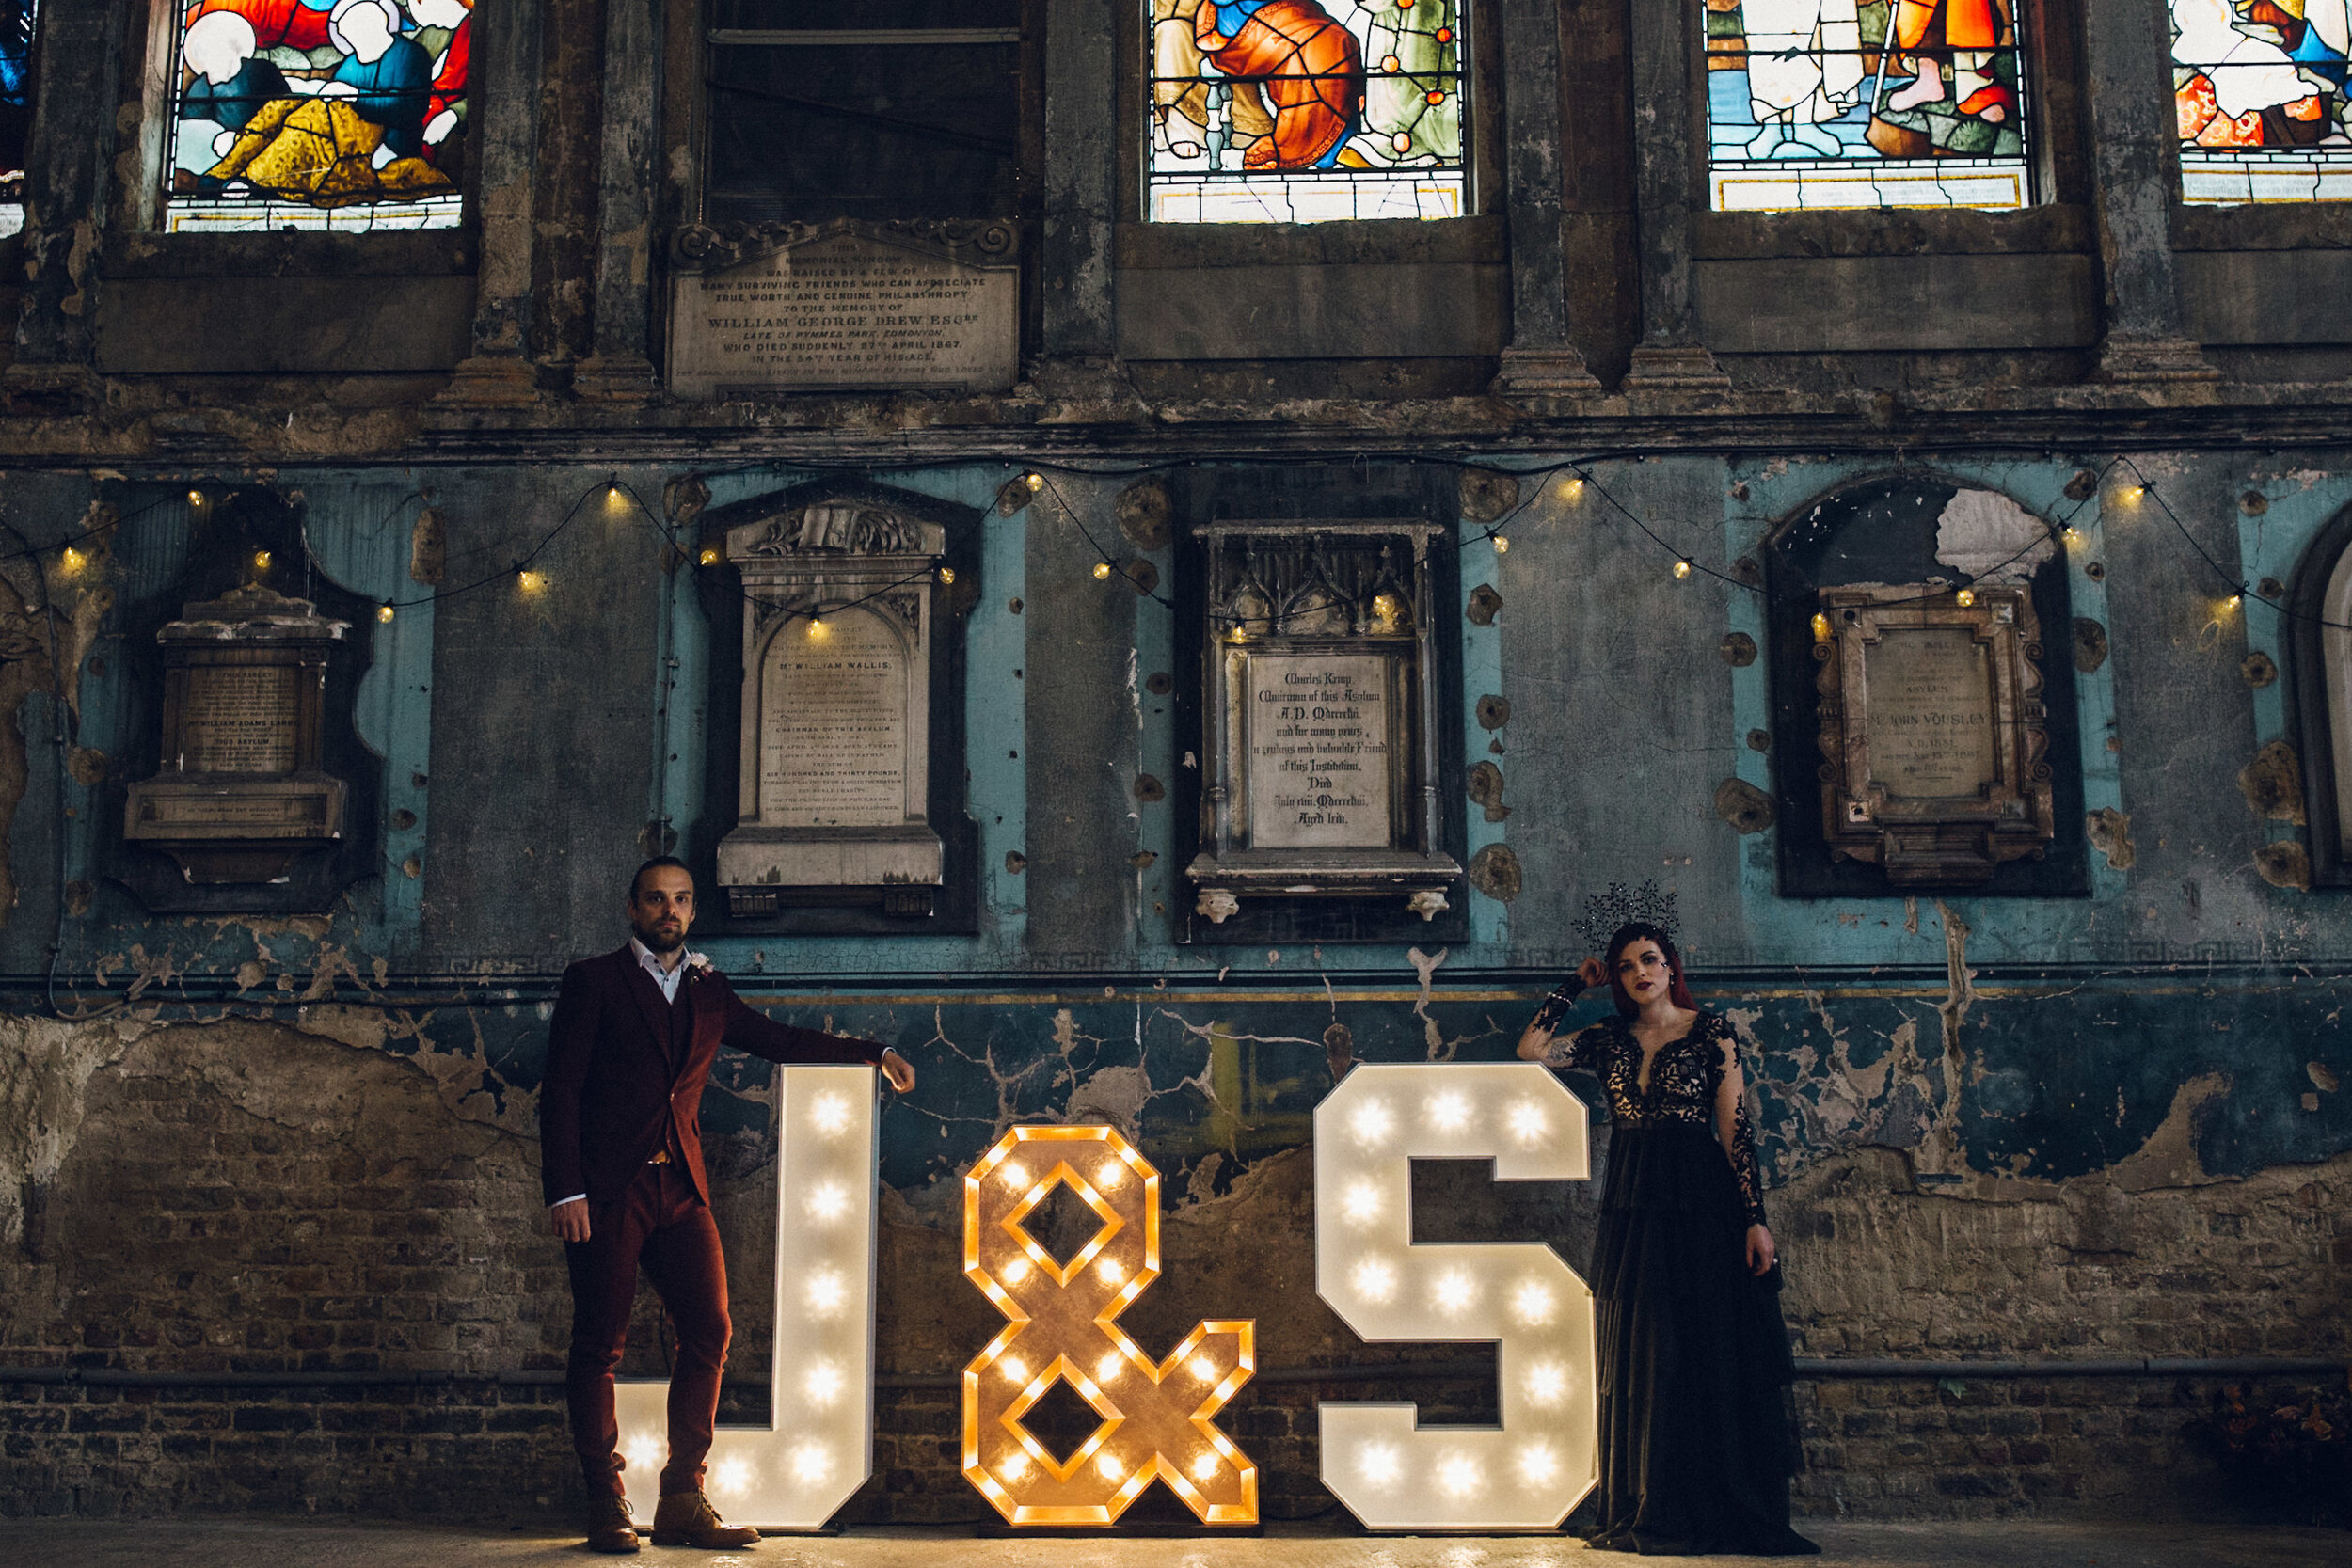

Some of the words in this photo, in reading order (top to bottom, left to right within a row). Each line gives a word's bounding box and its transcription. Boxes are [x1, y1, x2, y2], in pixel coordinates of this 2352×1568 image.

[832, 244, 856, 252] THIS
[786, 256, 847, 264] MEMORIAL
[852, 255, 902, 264] WINDOW
[874, 267, 898, 276] FEW
[701, 282, 732, 291] MANY
[737, 281, 800, 290] SURVIVING
[805, 280, 856, 289] FRIENDS
[891, 279, 912, 288] CAN
[915, 277, 986, 287] APPRECIATE
[716, 293, 744, 302] TRUE
[750, 293, 792, 302] WORTH
[797, 293, 820, 301] AND
[823, 292, 871, 300] GENUINE
[878, 291, 967, 300] PHILANTHROPY
[832, 303, 884, 312] MEMORY
[708, 316, 788, 328] WILLIAM
[798, 316, 867, 327] GEORGE
[876, 315, 923, 326] DREW
[743, 331, 771, 340] LATE
[796, 330, 843, 339] PYMMES
[723, 342, 751, 353] WHO
[756, 342, 787, 352] DIED
[791, 341, 854, 351] SUDDENLY
[892, 341, 927, 350] APRIL
[752, 355, 764, 363] IN
[770, 355, 792, 363] THE
[829, 354, 861, 362] YEAR
[866, 354, 881, 362] OF
[883, 353, 905, 362] HIS
[1285, 672, 1322, 685] Charles
[1906, 685, 1949, 693] ASYLUM
[1259, 689, 1307, 703] Chairman
[1309, 689, 1319, 702] of
[1321, 689, 1339, 702] this
[1341, 689, 1380, 704] Asylum
[1890, 713, 1918, 727] JOHN
[1276, 723, 1294, 736] and
[1295, 723, 1309, 736] for
[1310, 727, 1336, 737] many
[1253, 746, 1260, 754] a
[1262, 741, 1295, 756] zealous
[1297, 741, 1315, 754] and
[1316, 741, 1355, 754] valuable
[1357, 740, 1388, 755] Friend
[1279, 759, 1290, 772] of
[1291, 759, 1309, 772] this
[1307, 776, 1333, 791] Died
[1274, 794, 1295, 812] July
[1295, 812, 1324, 827] Aged
[614, 1064, 879, 1530] J
[961, 1124, 1257, 1528] &
[1315, 1061, 1599, 1530] S
